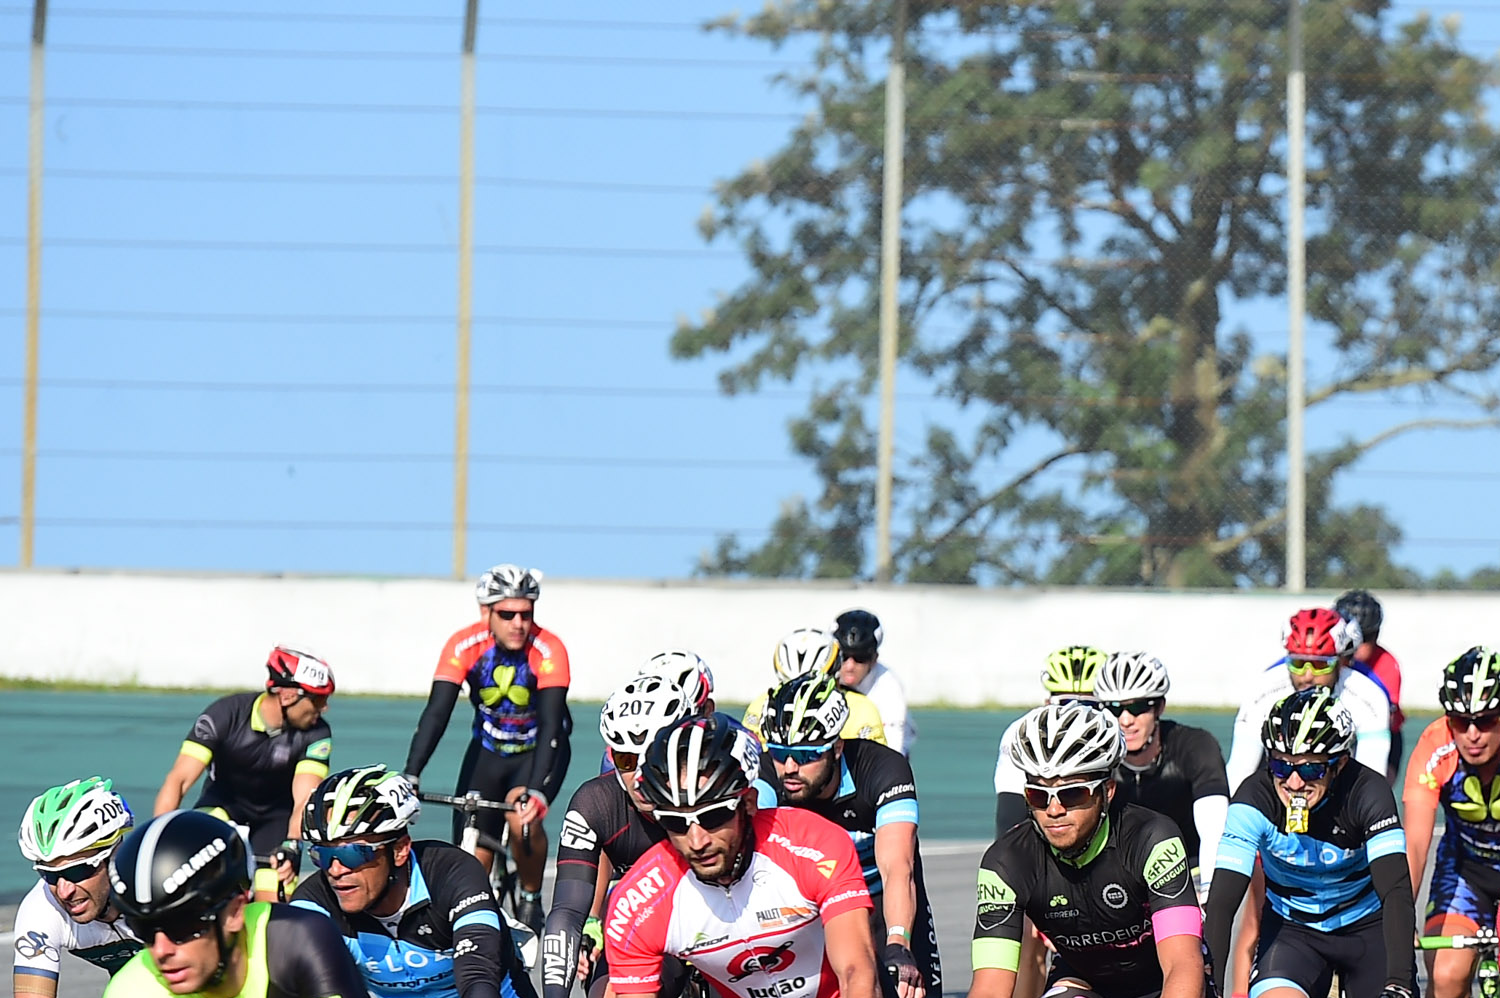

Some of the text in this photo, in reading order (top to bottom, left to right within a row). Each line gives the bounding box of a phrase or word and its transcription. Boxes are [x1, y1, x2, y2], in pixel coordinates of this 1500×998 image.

[619, 700, 655, 718] 207
[825, 700, 847, 730] 504
[1147, 842, 1181, 881] GFNY
[1153, 861, 1188, 890] URUGUAY
[606, 866, 666, 942] INPART
[756, 907, 781, 924] PALLET
[1052, 917, 1152, 948] ORREDEIRA
[544, 929, 568, 987] TEAM
